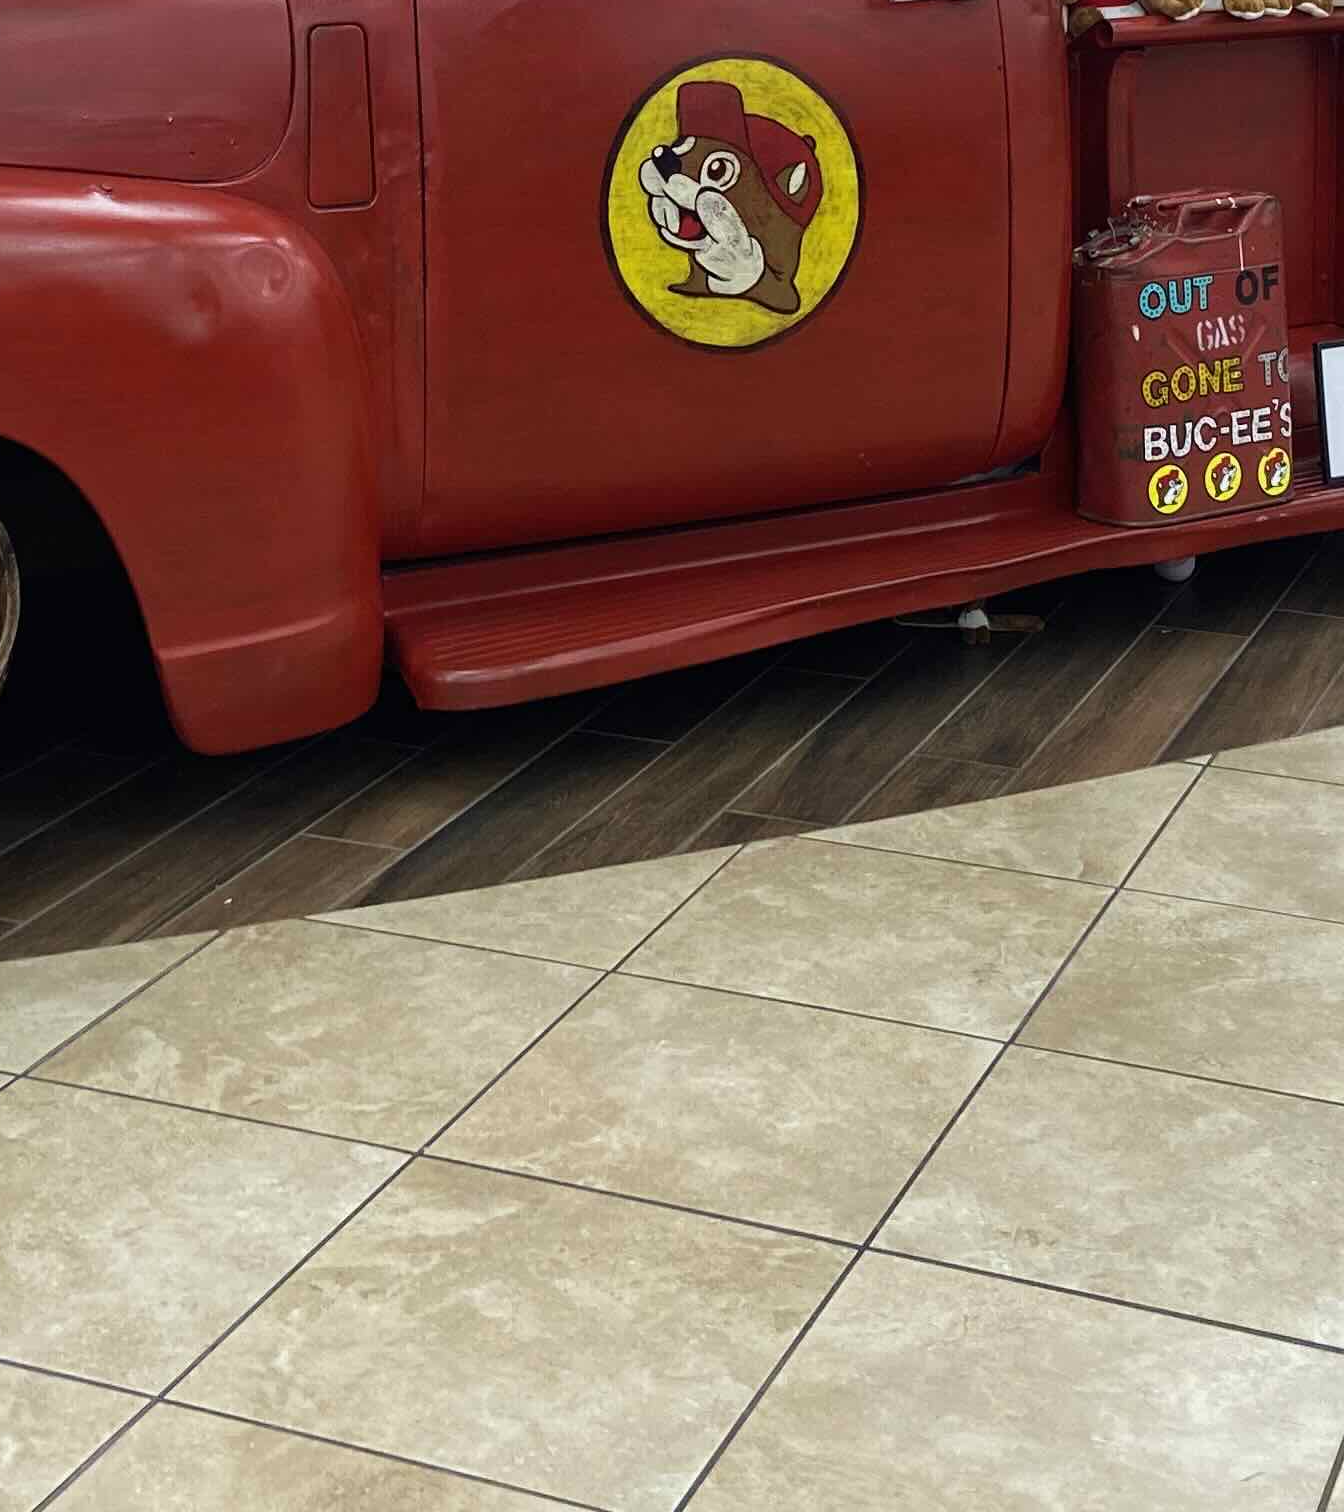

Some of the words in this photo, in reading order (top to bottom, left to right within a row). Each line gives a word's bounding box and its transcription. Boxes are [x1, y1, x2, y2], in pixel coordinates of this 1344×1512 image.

[1138, 274, 1214, 319] OUT
[1235, 265, 1279, 305] OF
[1196, 315, 1246, 351] GAS
[1141, 357, 1244, 408] GONE
[1142, 399, 1292, 462] BUC-EE'S
